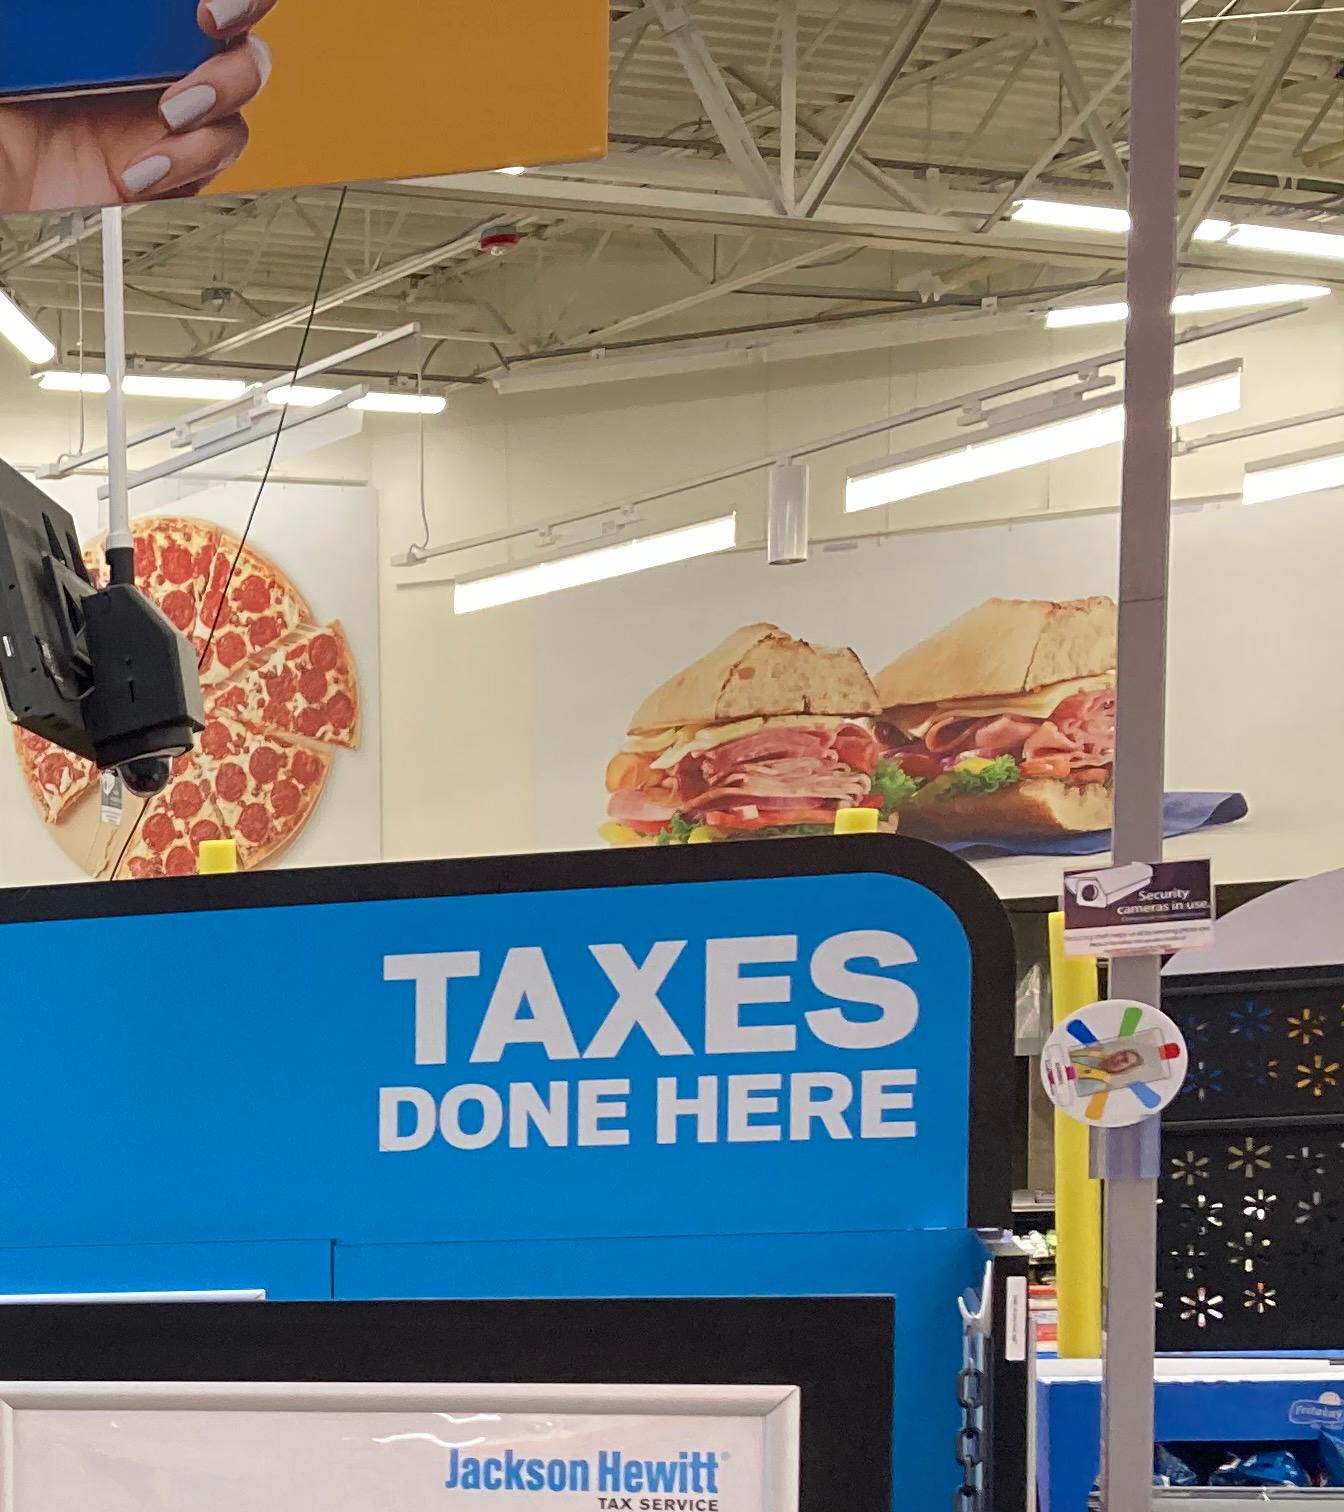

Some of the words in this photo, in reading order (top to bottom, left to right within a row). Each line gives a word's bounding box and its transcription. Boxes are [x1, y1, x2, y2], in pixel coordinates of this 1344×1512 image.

[1116, 901, 1169, 915] cameras
[1171, 901, 1184, 910] in
[1138, 888, 1190, 901] Security
[383, 929, 920, 1065] TAXES
[378, 1078, 631, 1153] DONE
[656, 1068, 919, 1145] HERE
[444, 1448, 590, 1491] Jackson
[598, 1450, 719, 1494] Hewitt
[598, 1497, 633, 1511] TAX
[639, 1498, 719, 1512] SERVICE
